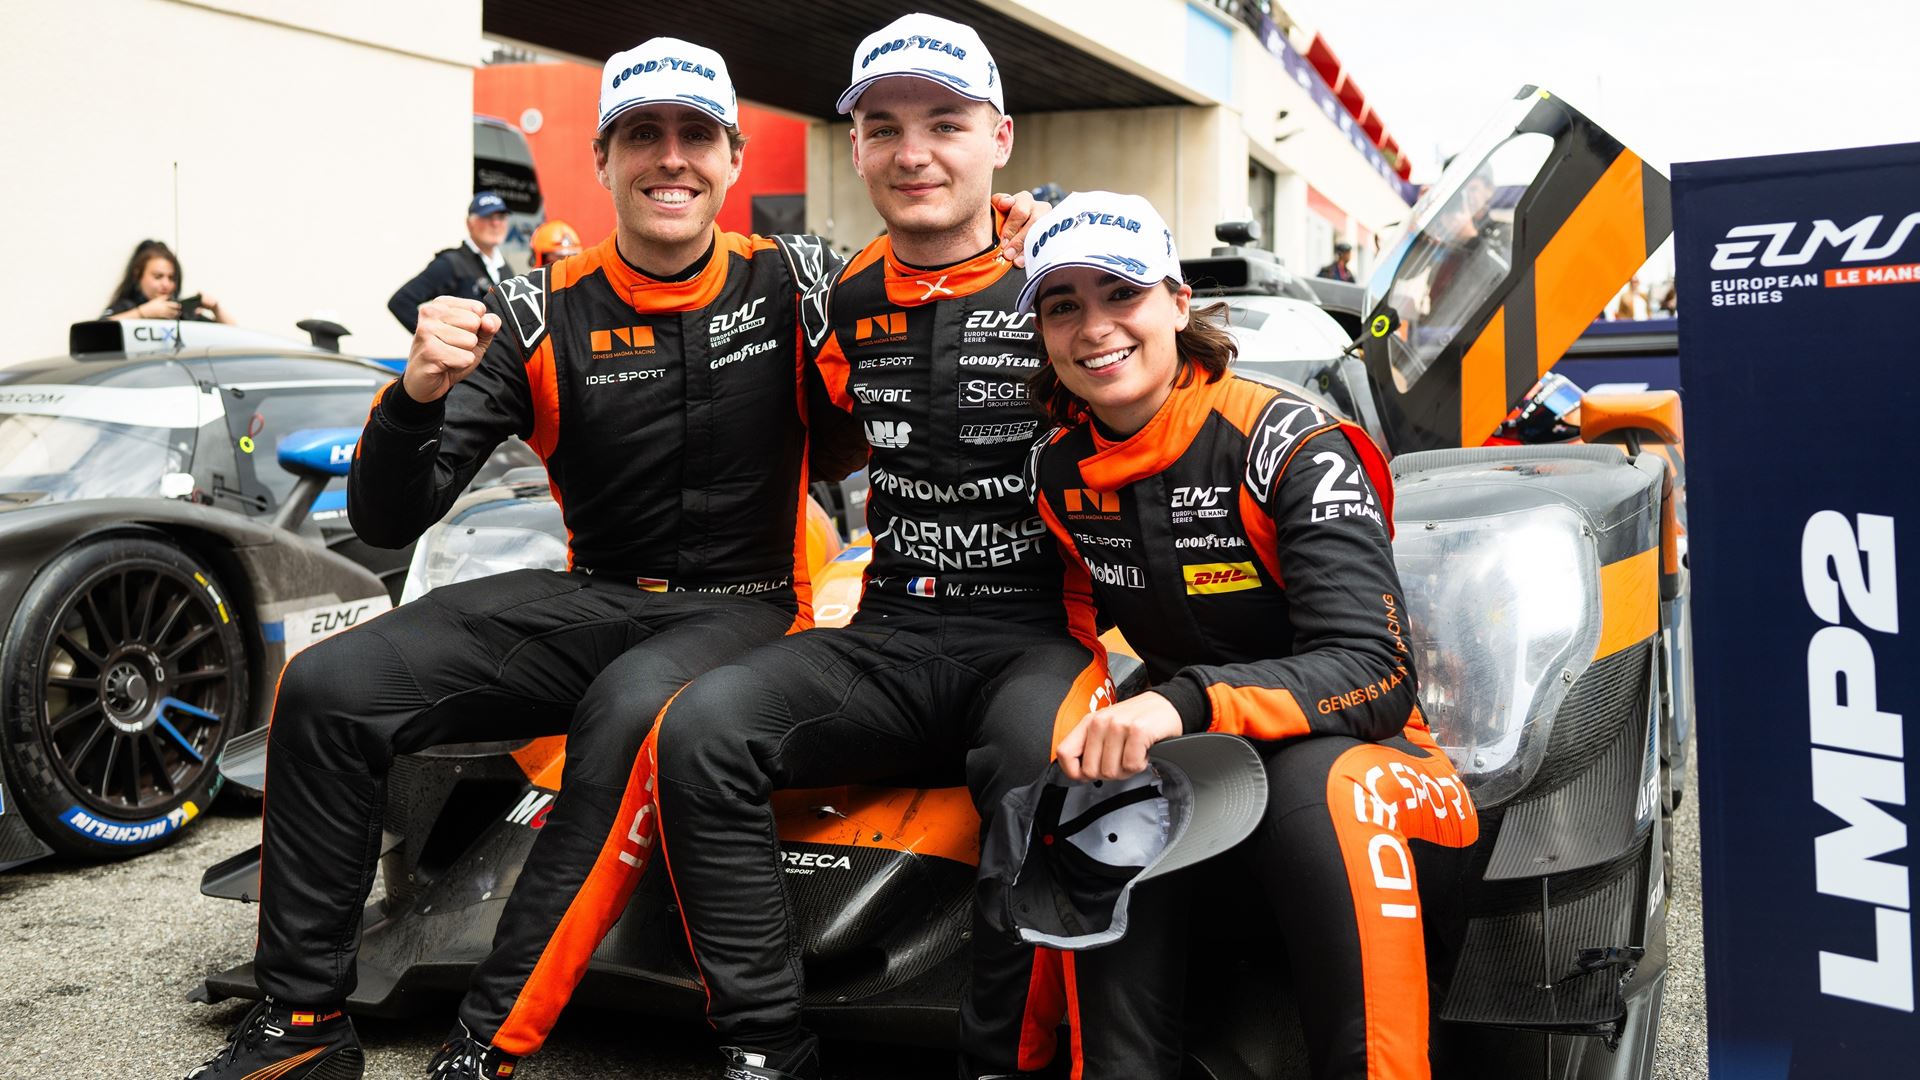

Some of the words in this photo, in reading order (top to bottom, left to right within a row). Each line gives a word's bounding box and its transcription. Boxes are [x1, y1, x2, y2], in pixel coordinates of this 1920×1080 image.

[862, 35, 966, 68] GOODYEAR
[612, 57, 716, 89] GOODYEAR
[1032, 211, 1141, 257] GOODYEAR
[1711, 273, 1818, 293] EUROPEAN
[1836, 271, 1860, 285] LE
[1867, 266, 1920, 282] MANS
[1711, 290, 1783, 307] SERIES
[709, 297, 766, 334] ELMS
[965, 310, 1037, 329] ELMS
[134, 327, 176, 341] CLX
[710, 328, 739, 343] EUROPEAN
[710, 338, 730, 348] SERIES
[1011, 331, 1029, 339] MANS
[710, 339, 778, 370] GOODYEAR
[959, 353, 1040, 369] GOODYEAR
[959, 420, 1038, 439] RASCASSE
[1171, 486, 1231, 508] ELMS
[1311, 504, 1339, 523] LE
[901, 515, 1047, 550] DRIVING
[1175, 534, 1247, 549] GOODYEAR
[1193, 569, 1249, 586] DHL
[945, 583, 965, 597] M.
[311, 604, 369, 633] ELMS
[1317, 684, 1379, 715] GENESIS
[1801, 510, 1914, 1013] LMP2
[71, 811, 167, 841] MICHELIN
